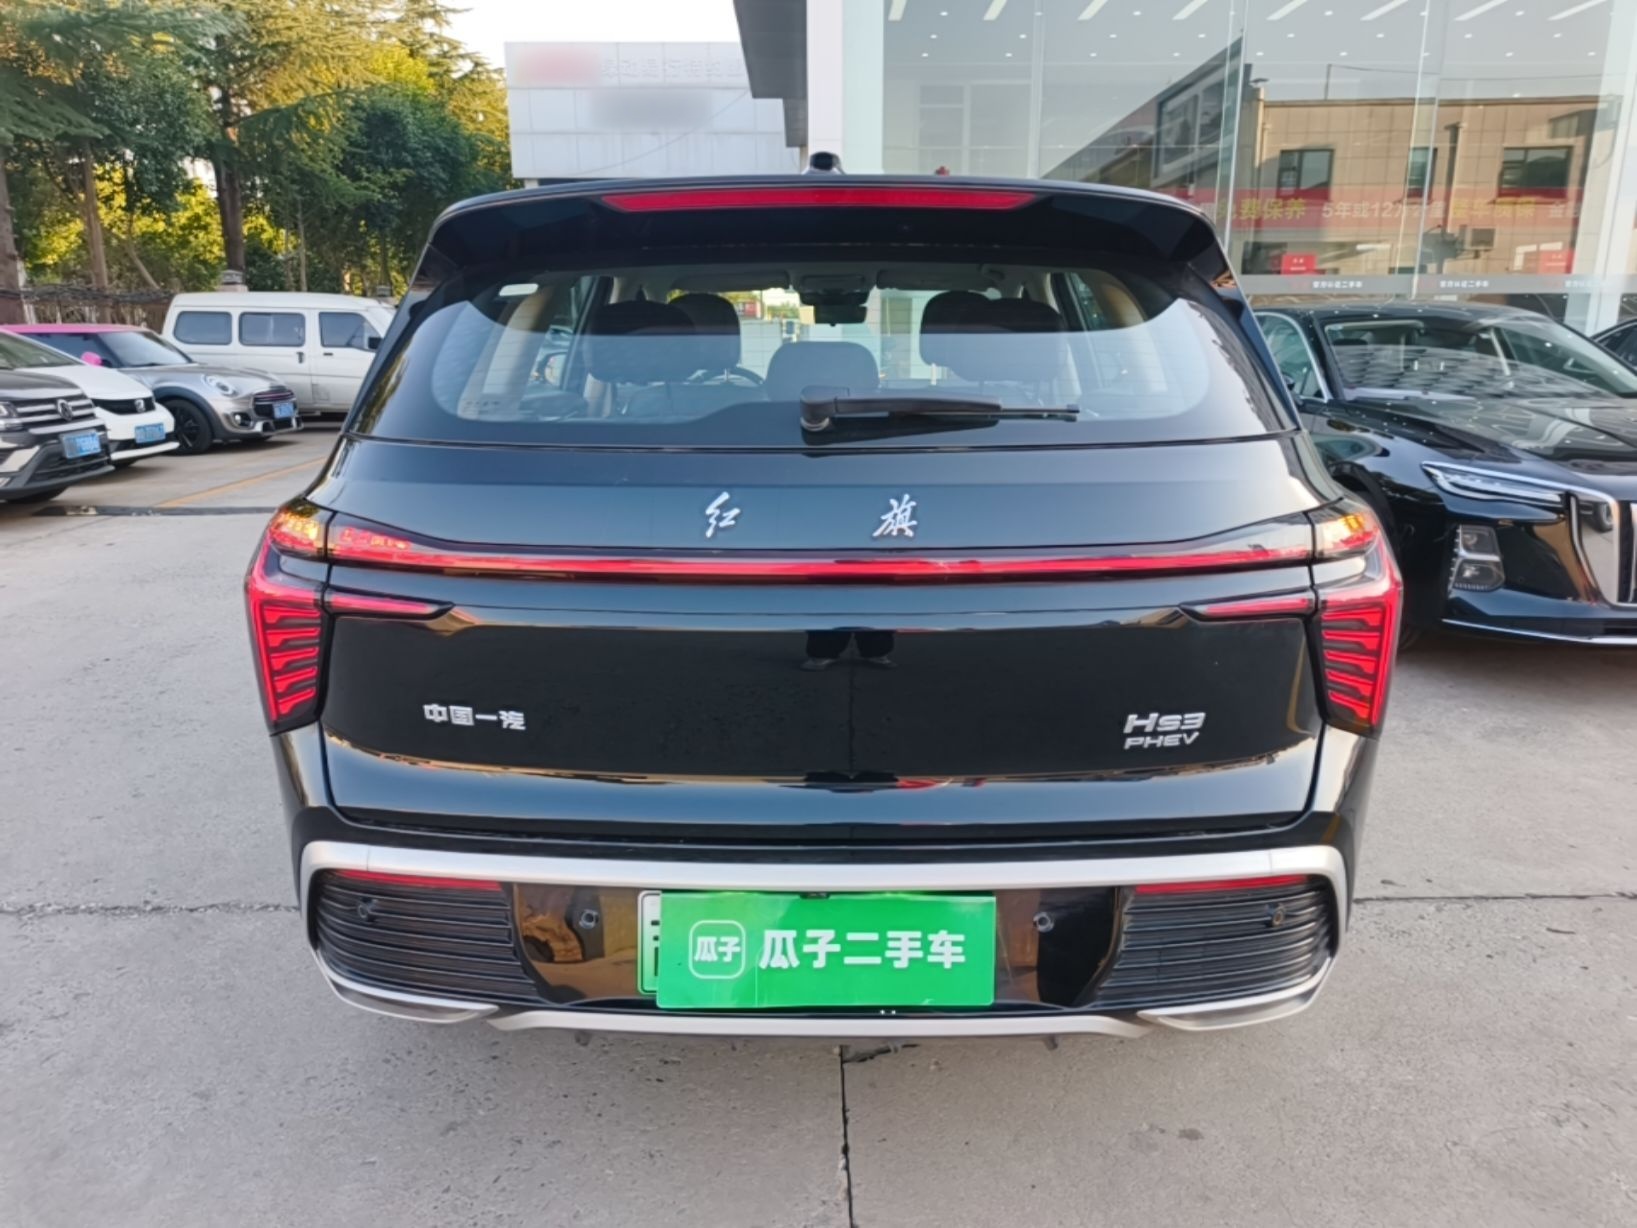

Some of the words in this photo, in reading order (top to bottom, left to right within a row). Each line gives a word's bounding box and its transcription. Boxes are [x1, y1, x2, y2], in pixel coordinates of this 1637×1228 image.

[705, 491, 918, 538] 红旗
[423, 703, 526, 730] 中国一汽
[1123, 711, 1206, 734] HS3
[1123, 731, 1200, 749] PHEV
[694, 935, 741, 962] 瓜子
[758, 928, 967, 970] 瓜子二手车
